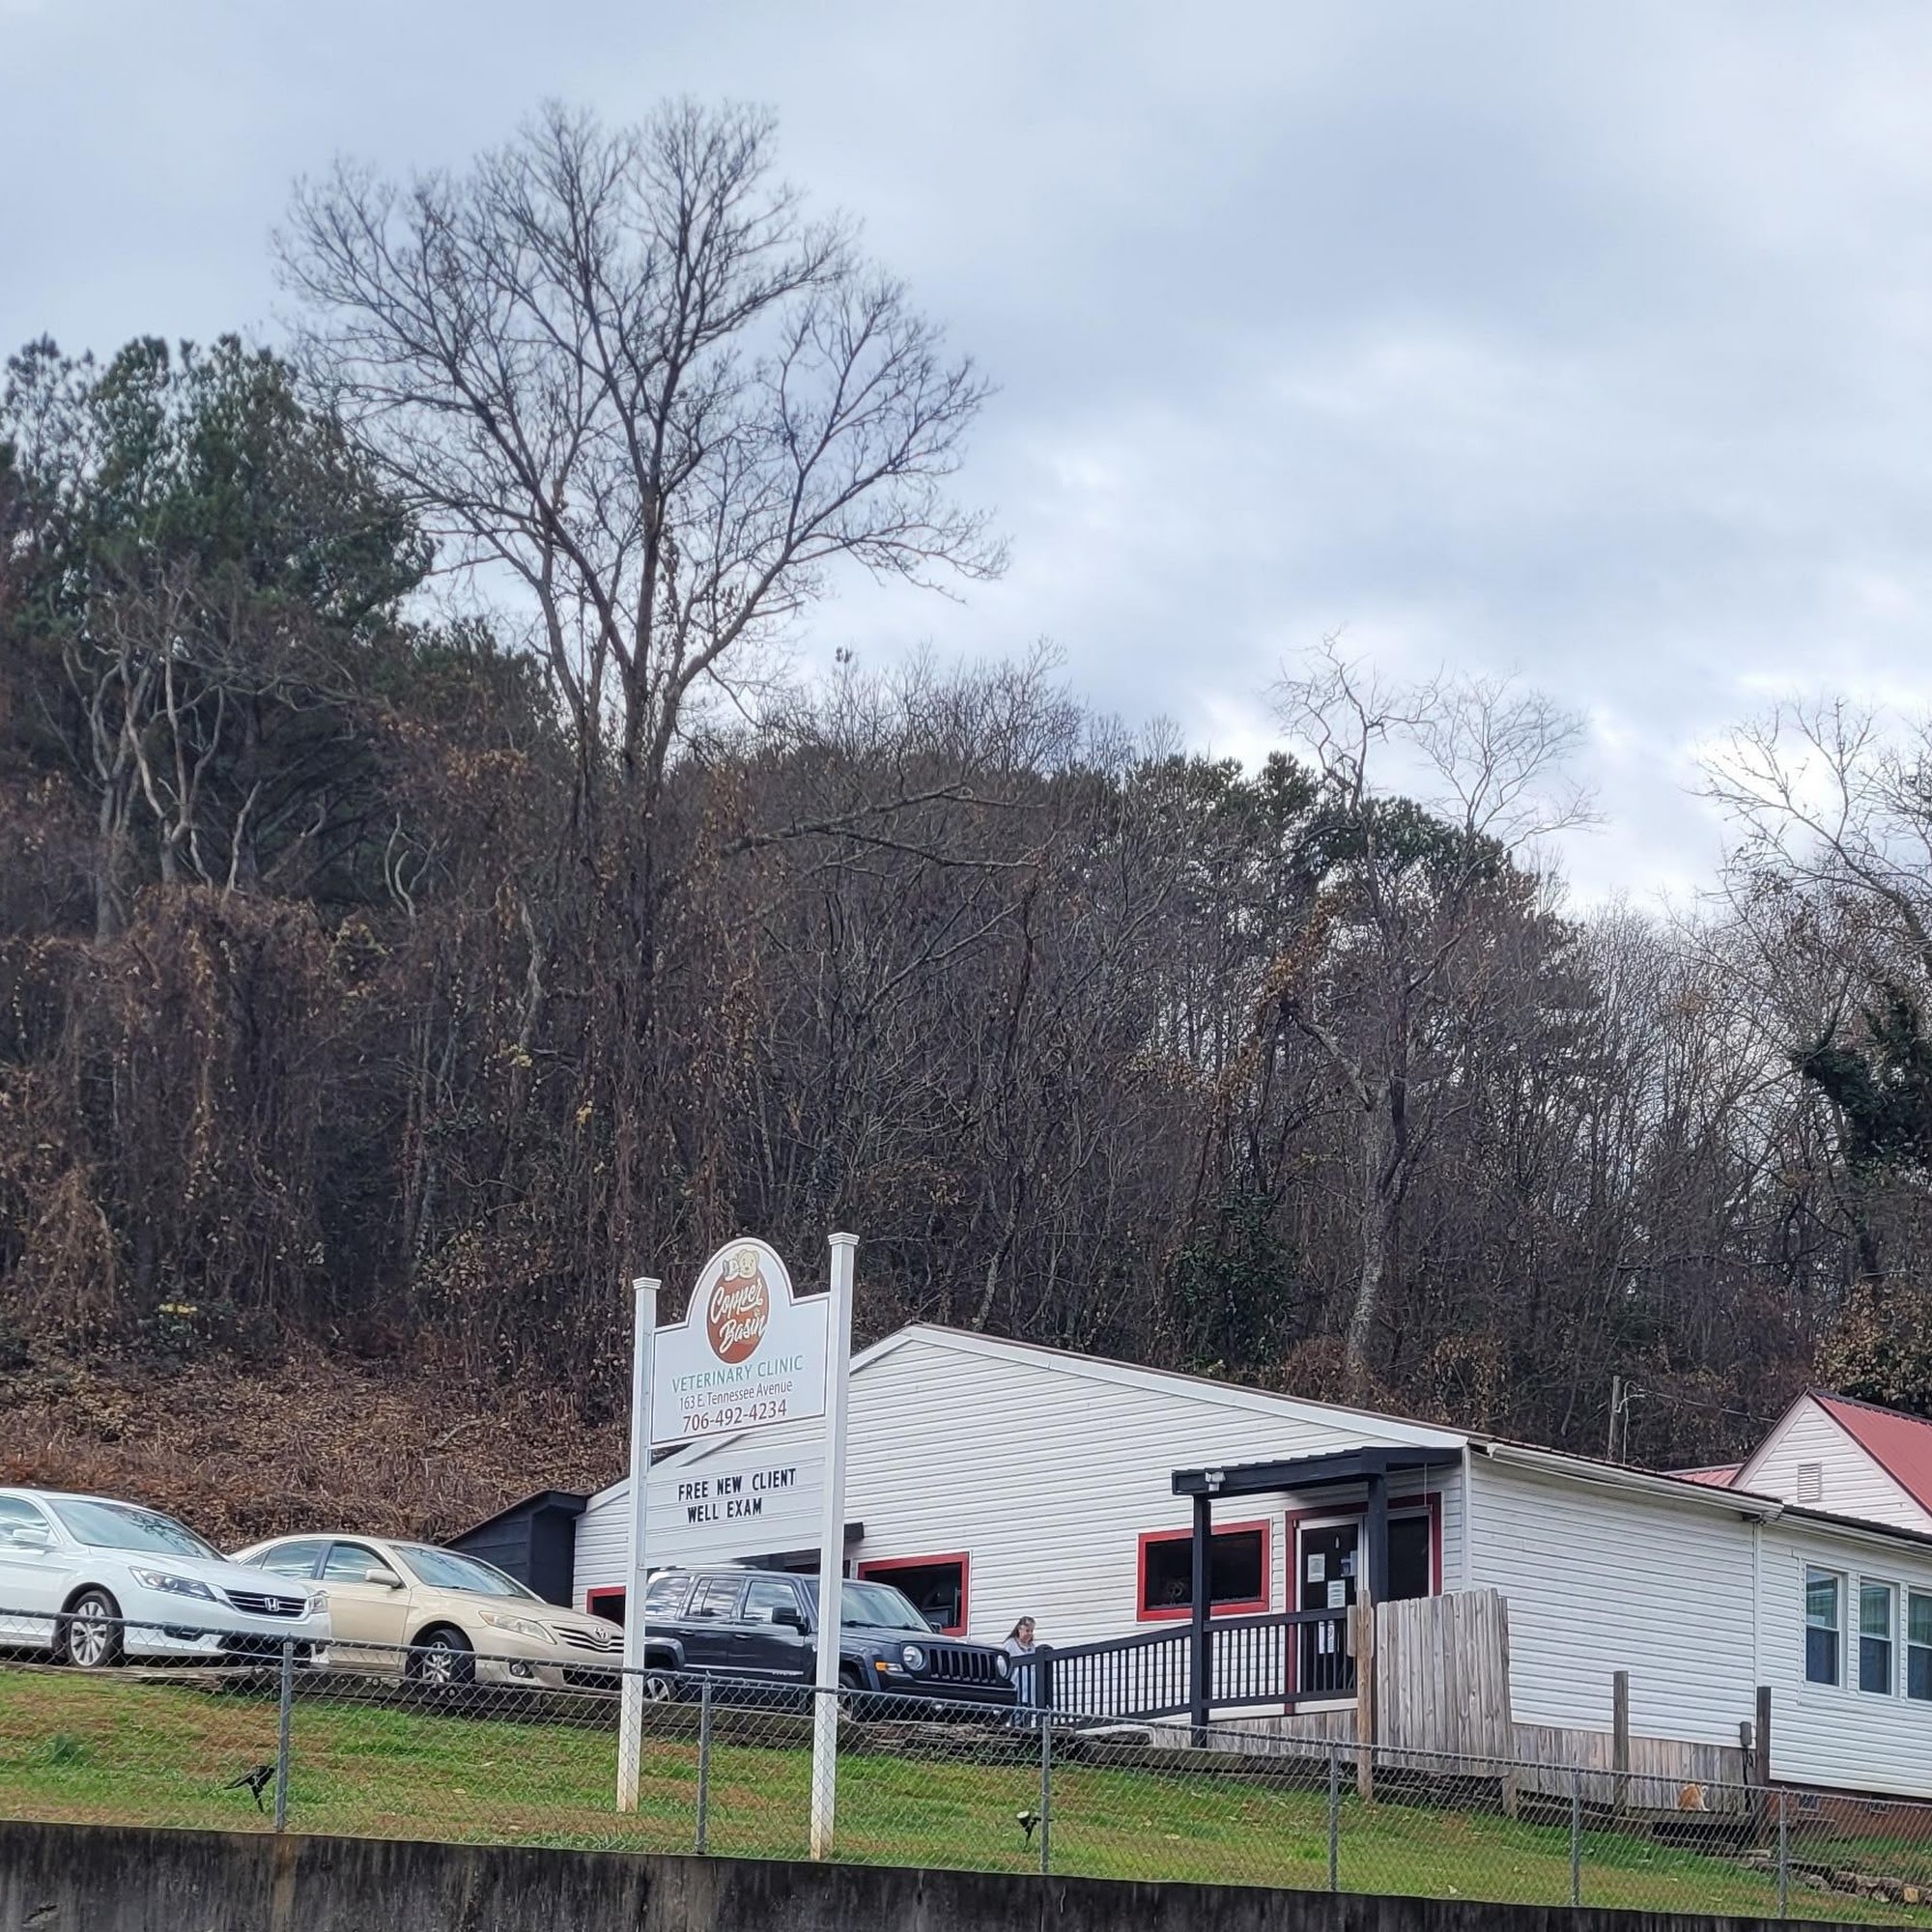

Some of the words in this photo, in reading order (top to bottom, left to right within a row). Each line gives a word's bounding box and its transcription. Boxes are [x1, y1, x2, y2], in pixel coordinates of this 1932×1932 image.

[710, 1278, 763, 1323] Copper
[719, 1310, 766, 1353] Basin
[672, 1364, 753, 1393] VETERINARY
[757, 1354, 803, 1378] CLINIC
[679, 1395, 696, 1410] 163
[707, 1387, 754, 1406] Tennessee
[756, 1380, 793, 1398] Avenue
[683, 1398, 787, 1433] 706-492-4234
[678, 1481, 709, 1501] FREE
[717, 1475, 743, 1496] NEW
[752, 1468, 796, 1491] CLIENT
[687, 1503, 720, 1523] WELL
[726, 1497, 762, 1519] EXAM
